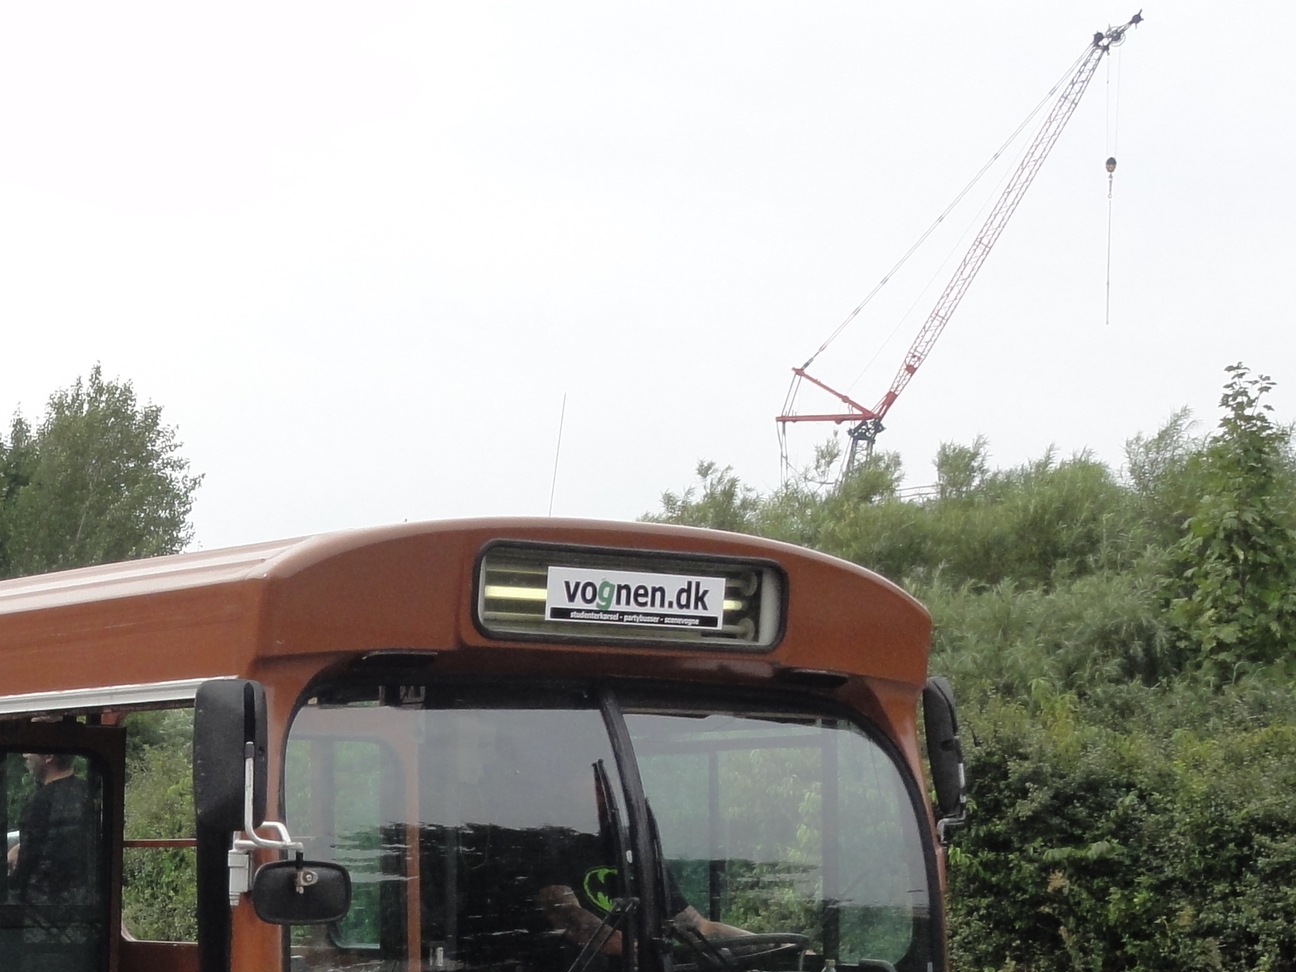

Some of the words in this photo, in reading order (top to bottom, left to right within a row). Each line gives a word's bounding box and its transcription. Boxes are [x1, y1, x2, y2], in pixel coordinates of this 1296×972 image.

[564, 578, 710, 611] vognen.dk
[623, 613, 660, 624] partybusser
[664, 617, 699, 626] scenevogne
